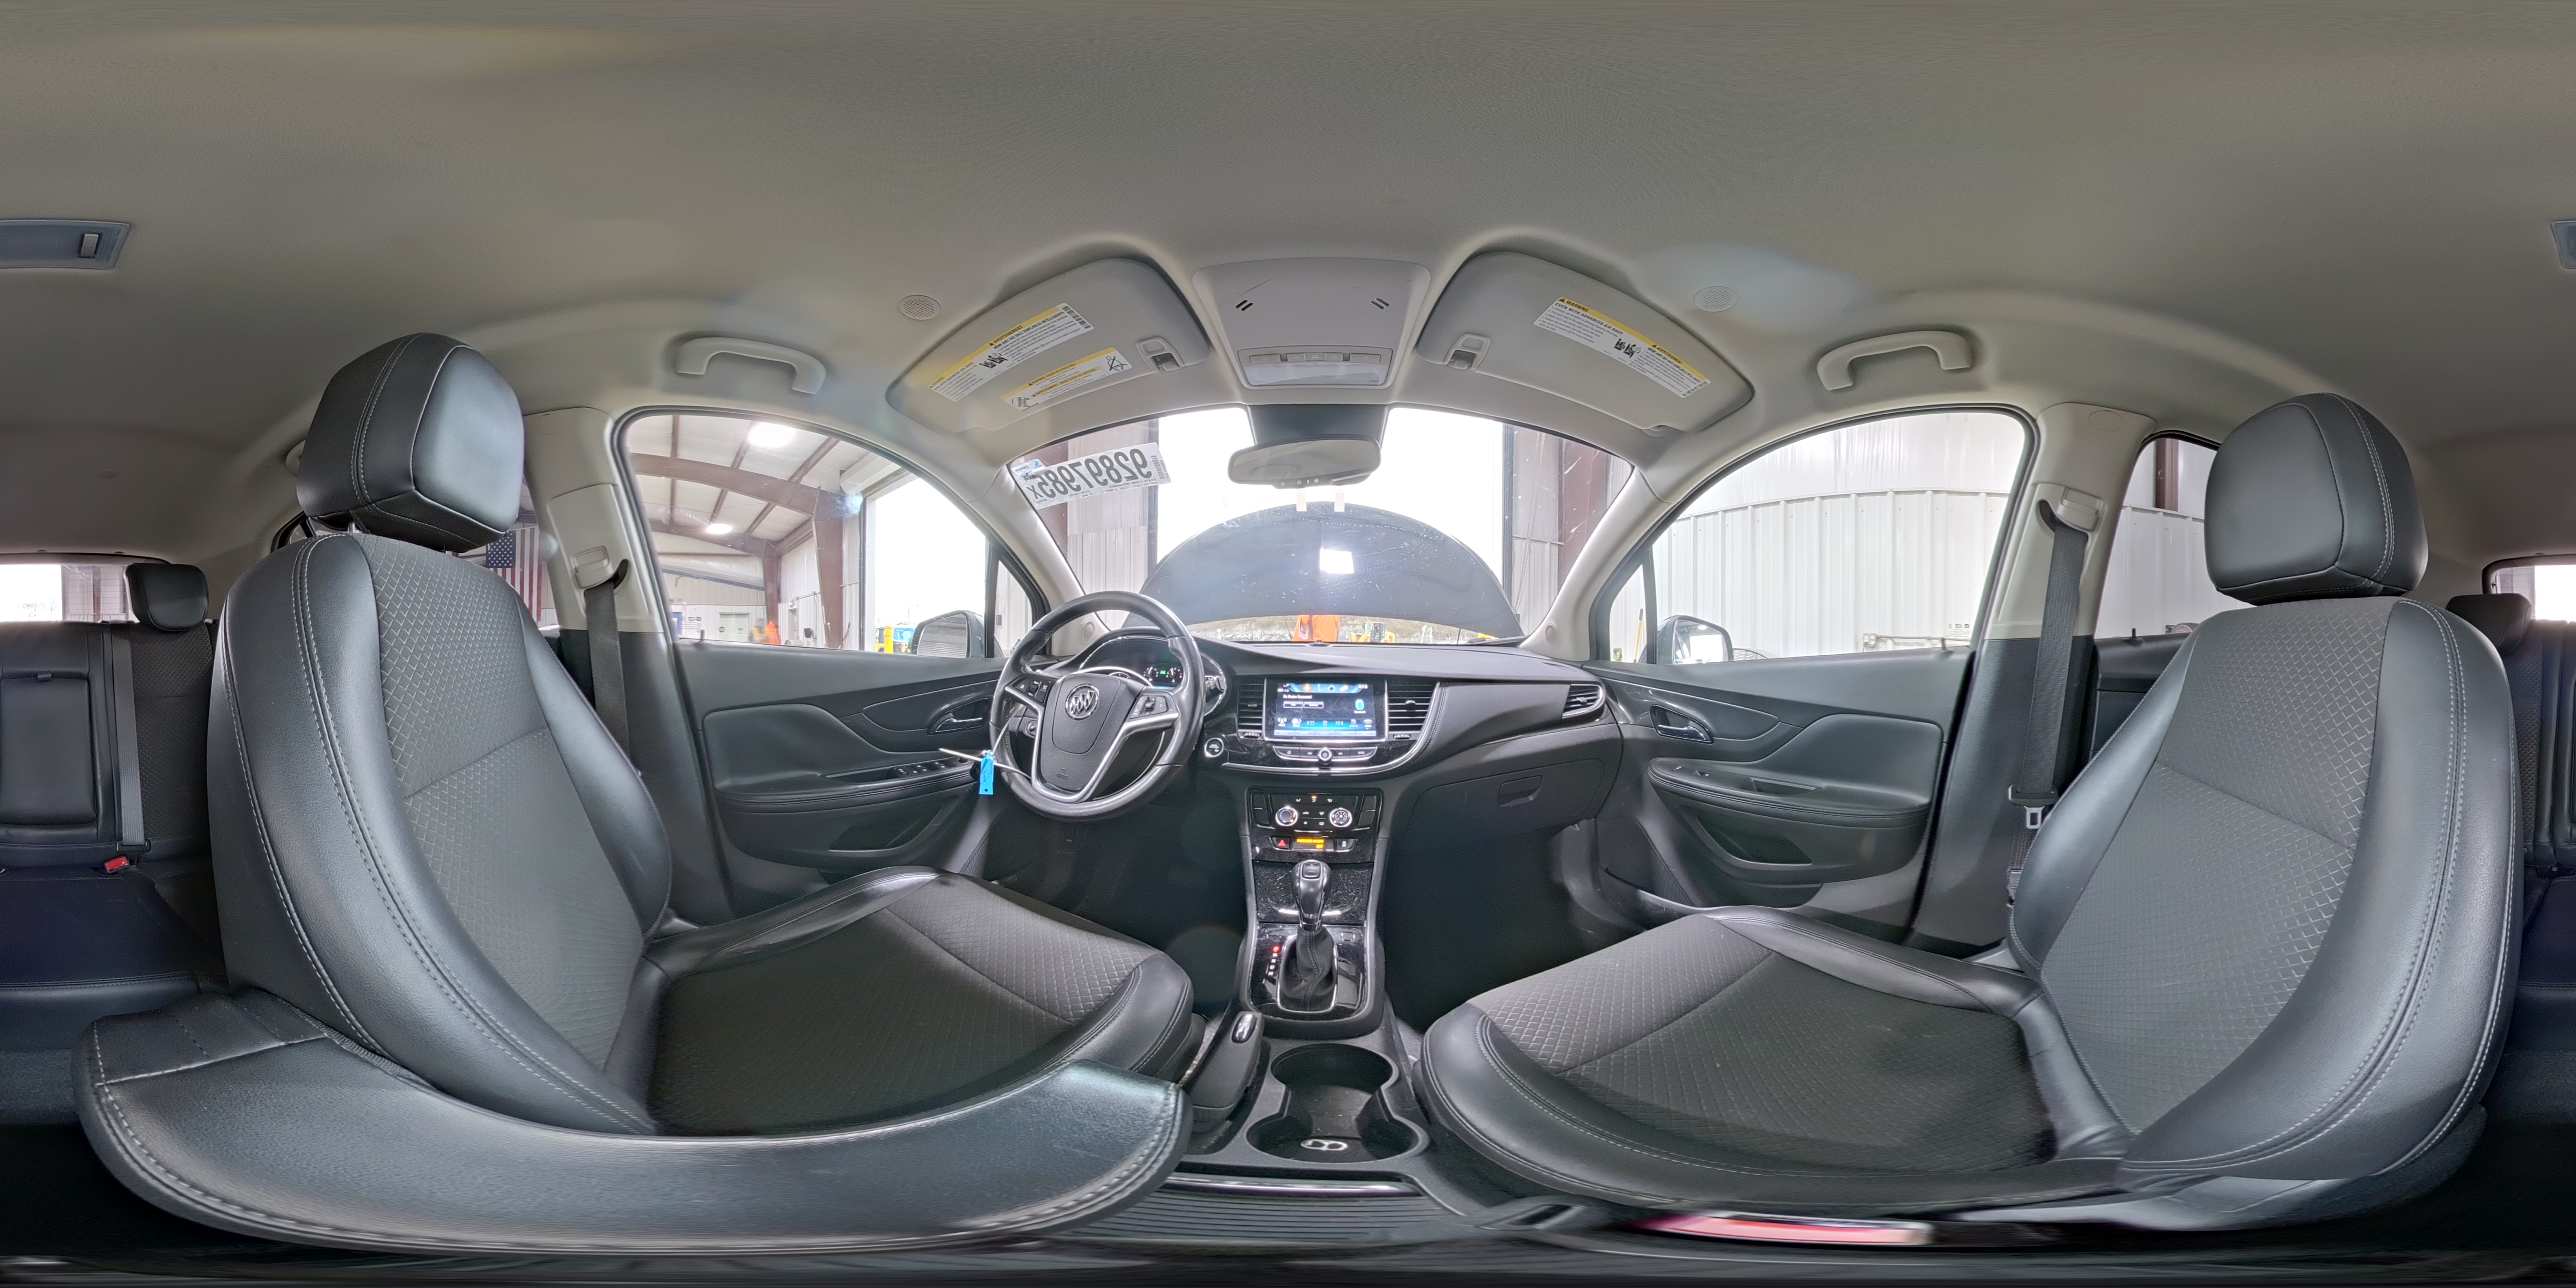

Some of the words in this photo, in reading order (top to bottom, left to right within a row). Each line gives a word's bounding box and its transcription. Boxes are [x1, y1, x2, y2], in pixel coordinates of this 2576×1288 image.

[1566, 300, 1589, 312] WARNING
[1581, 313, 1604, 325] ADVANCED
[993, 325, 1024, 344] AVERTISSEMENT
[1657, 347, 1683, 364] AVERTISSEMENT
